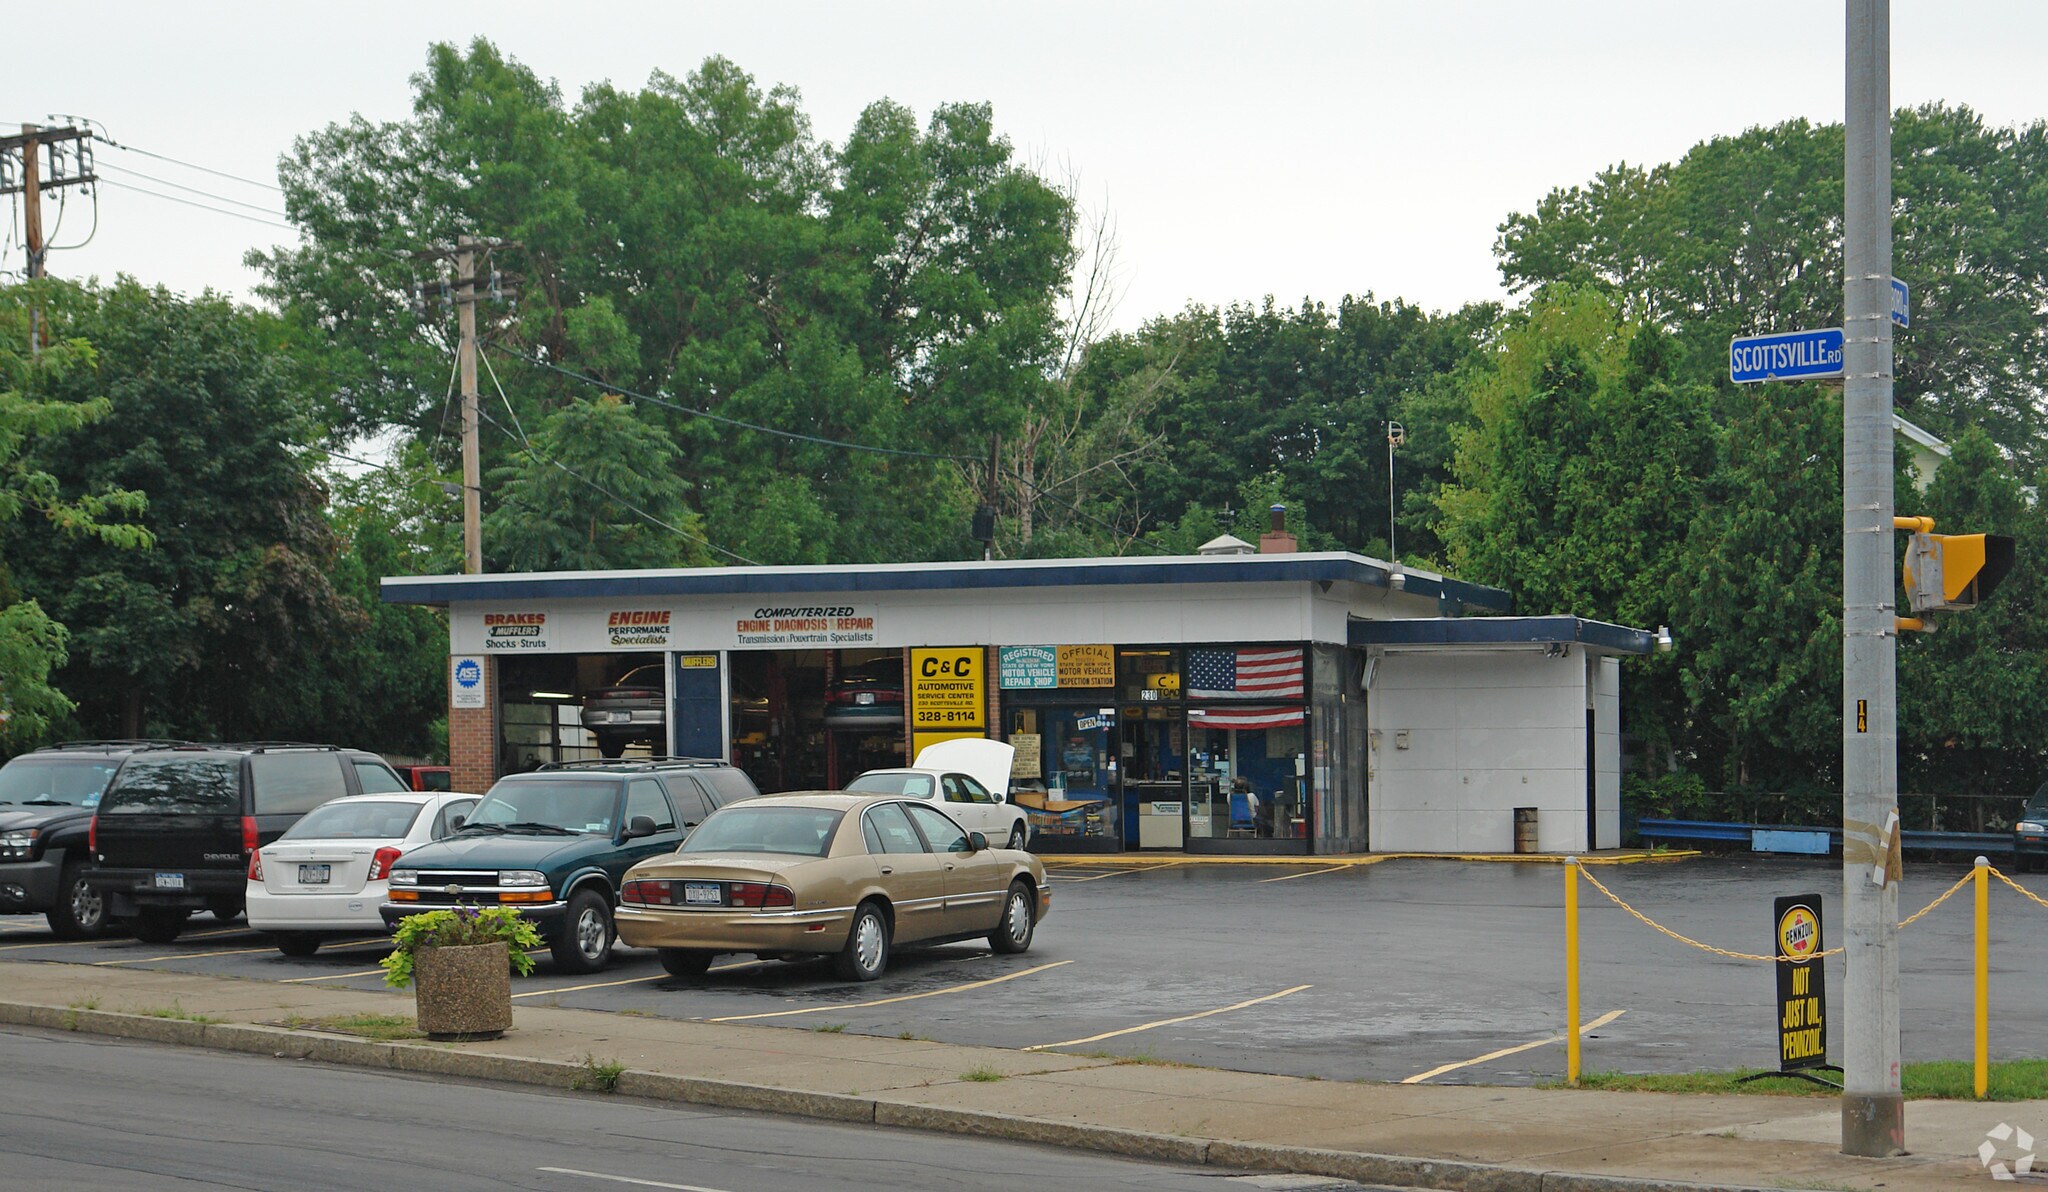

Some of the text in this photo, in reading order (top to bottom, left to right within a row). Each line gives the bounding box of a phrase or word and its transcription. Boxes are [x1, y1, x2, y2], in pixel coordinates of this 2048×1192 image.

[1733, 339, 1841, 373] SCOTTSVILLE RD
[608, 611, 671, 625] ENGINE
[754, 607, 854, 618] COMPUTERIZED
[484, 613, 545, 625] BRAKES
[737, 619, 771, 632] ENGINE
[774, 618, 828, 632] DIAGNOSIS
[837, 617, 873, 630] REPAIR
[495, 626, 539, 636] MUFFLERS
[608, 626, 670, 635] PERFORMANCE
[485, 639, 546, 648] Shocks Struts
[611, 634, 667, 646] Specialists
[737, 634, 785, 644] Transmission
[790, 633, 827, 643] Powertrain
[830, 632, 873, 643] Specialists
[1003, 648, 1054, 663] REGISTERED
[1062, 647, 1109, 660] OFFICIAL
[683, 657, 715, 667] MUFFLERS
[922, 657, 971, 677] C & C
[459, 668, 477, 678] ASE
[1002, 668, 1055, 677] MOTOR VEHICLE
[1059, 667, 1112, 675] MOTOR VEHICLE
[1005, 677, 1052, 687] REPAIR SHOP
[1142, 690, 1157, 700] 230
[918, 712, 975, 721] 328-8114
[1080, 719, 1095, 728] OPEN
[1785, 921, 1813, 946] PENNZOIL
[1792, 967, 1810, 995] NOT
[1783, 996, 1822, 1029] JUST OIL,
